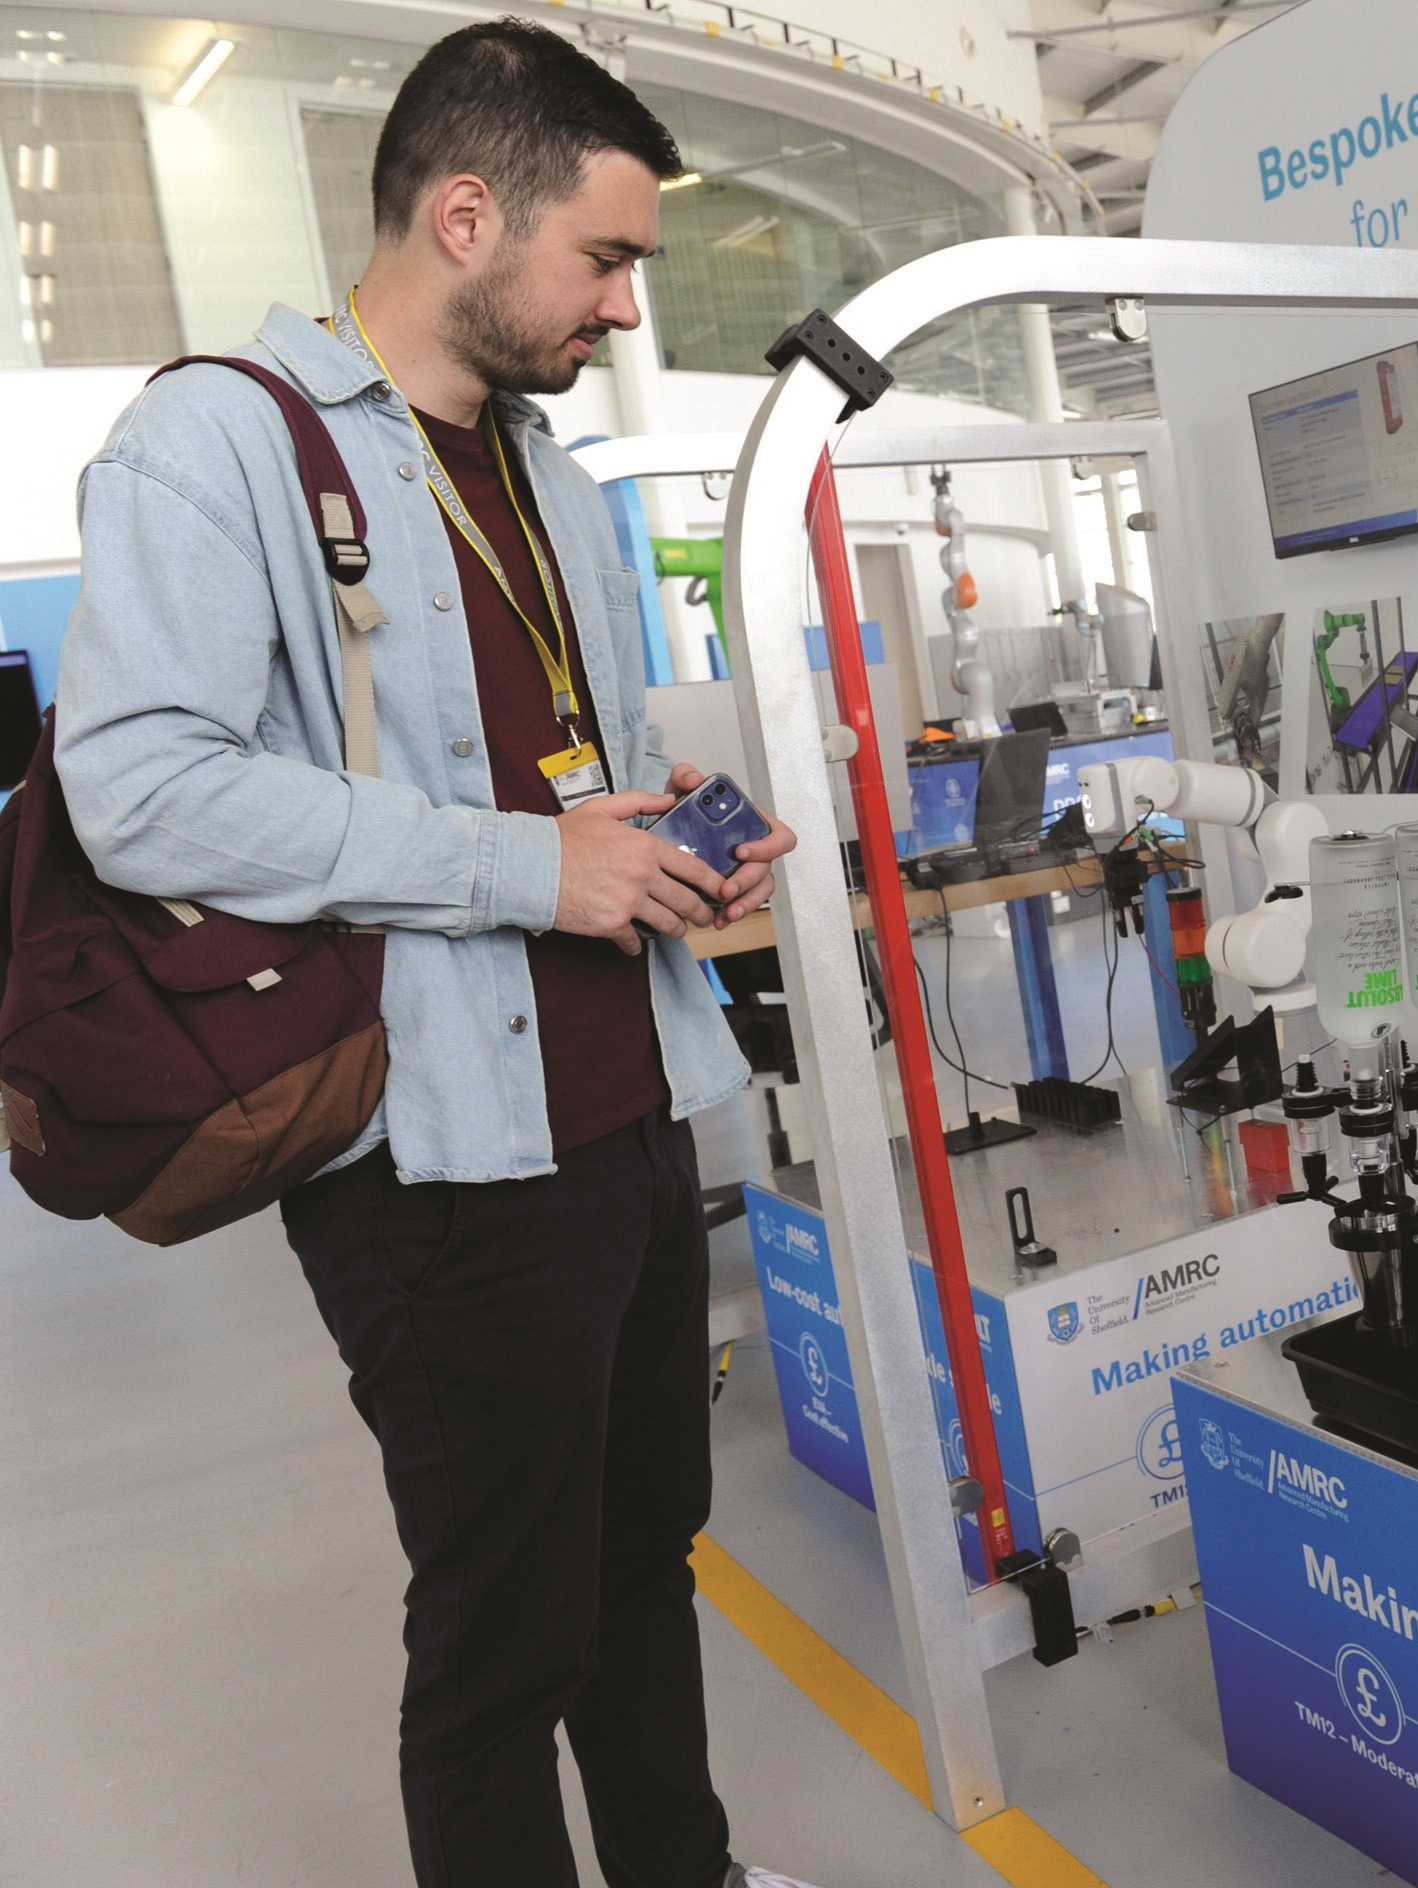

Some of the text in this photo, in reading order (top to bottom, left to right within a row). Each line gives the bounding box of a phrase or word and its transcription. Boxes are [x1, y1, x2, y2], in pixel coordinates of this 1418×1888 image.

[1350, 198, 1408, 248] for
[338, 322, 375, 370] VISITO
[429, 464, 468, 526] VISITOR
[1364, 967, 1398, 990] LIME
[1144, 1253, 1221, 1299] AMRC
[766, 1266, 822, 1316] Low-cost
[1087, 1294, 1104, 1305] The
[1087, 1294, 1131, 1315] University
[1144, 1279, 1217, 1308] Advanced Manufacturing
[1145, 1293, 1196, 1316] Research Centre
[1089, 1314, 1100, 1325] Of
[1091, 1332, 1211, 1396] Making
[1227, 1431, 1242, 1446] The
[1230, 1444, 1264, 1469] University
[1231, 1455, 1241, 1468] Of
[1277, 1452, 1348, 1509] AMRC
[1150, 1484, 1189, 1508] TM1
[1278, 1481, 1349, 1523] Advanced Manufacturing
[1279, 1490, 1328, 1520] Research Centre
[1293, 1701, 1336, 1740] TM12
